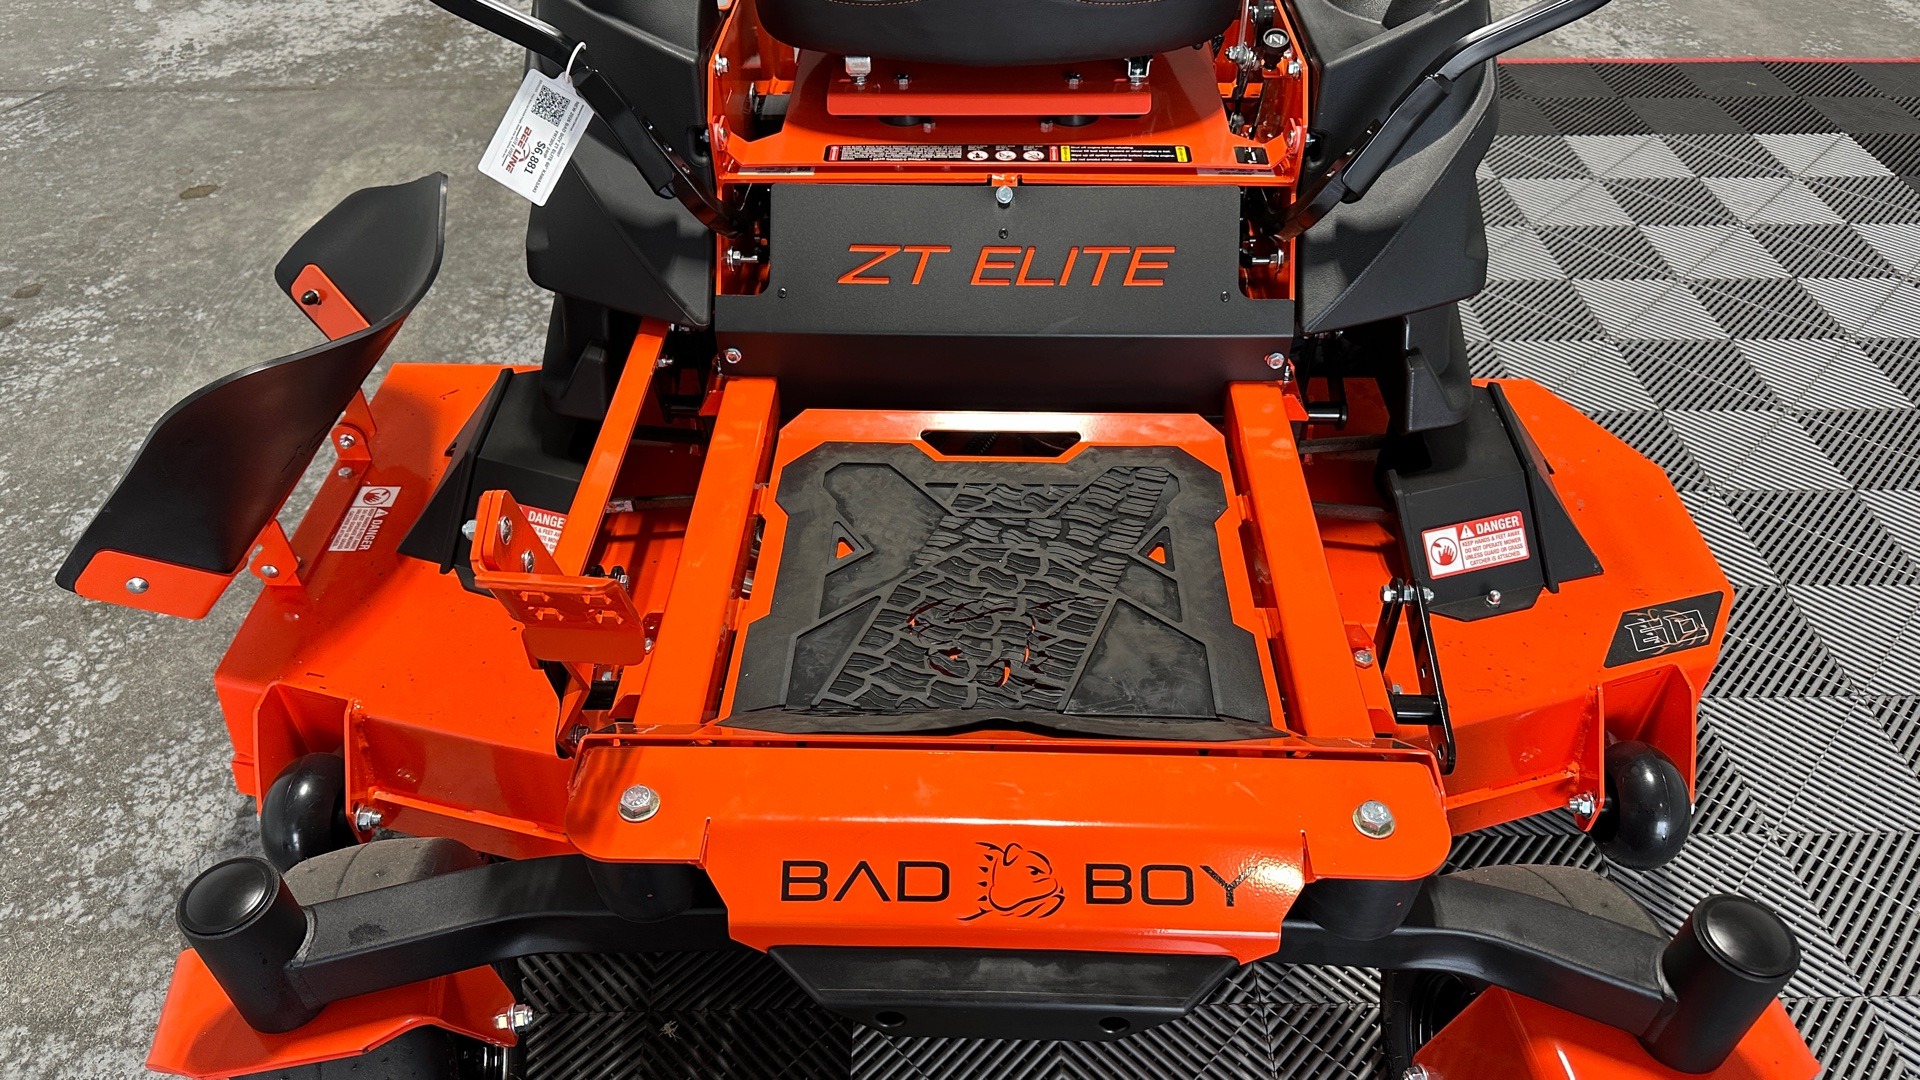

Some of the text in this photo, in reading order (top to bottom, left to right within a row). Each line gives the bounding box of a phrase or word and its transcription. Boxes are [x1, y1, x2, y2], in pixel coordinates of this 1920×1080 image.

[517, 126, 532, 150] BEE
[505, 149, 521, 174] LINE
[523, 140, 547, 176] $6,881
[837, 244, 1176, 286] ZT ELITE
[528, 510, 566, 528] DANGE
[1476, 516, 1520, 534] DANGER
[358, 520, 383, 550] DANGER
[1482, 541, 1502, 550] OPERATE
[1504, 537, 1521, 545] MOWER
[1465, 552, 1483, 560] UNLESS
[1470, 558, 1491, 566] CATCHER
[781, 860, 1258, 907] BAD BOY
